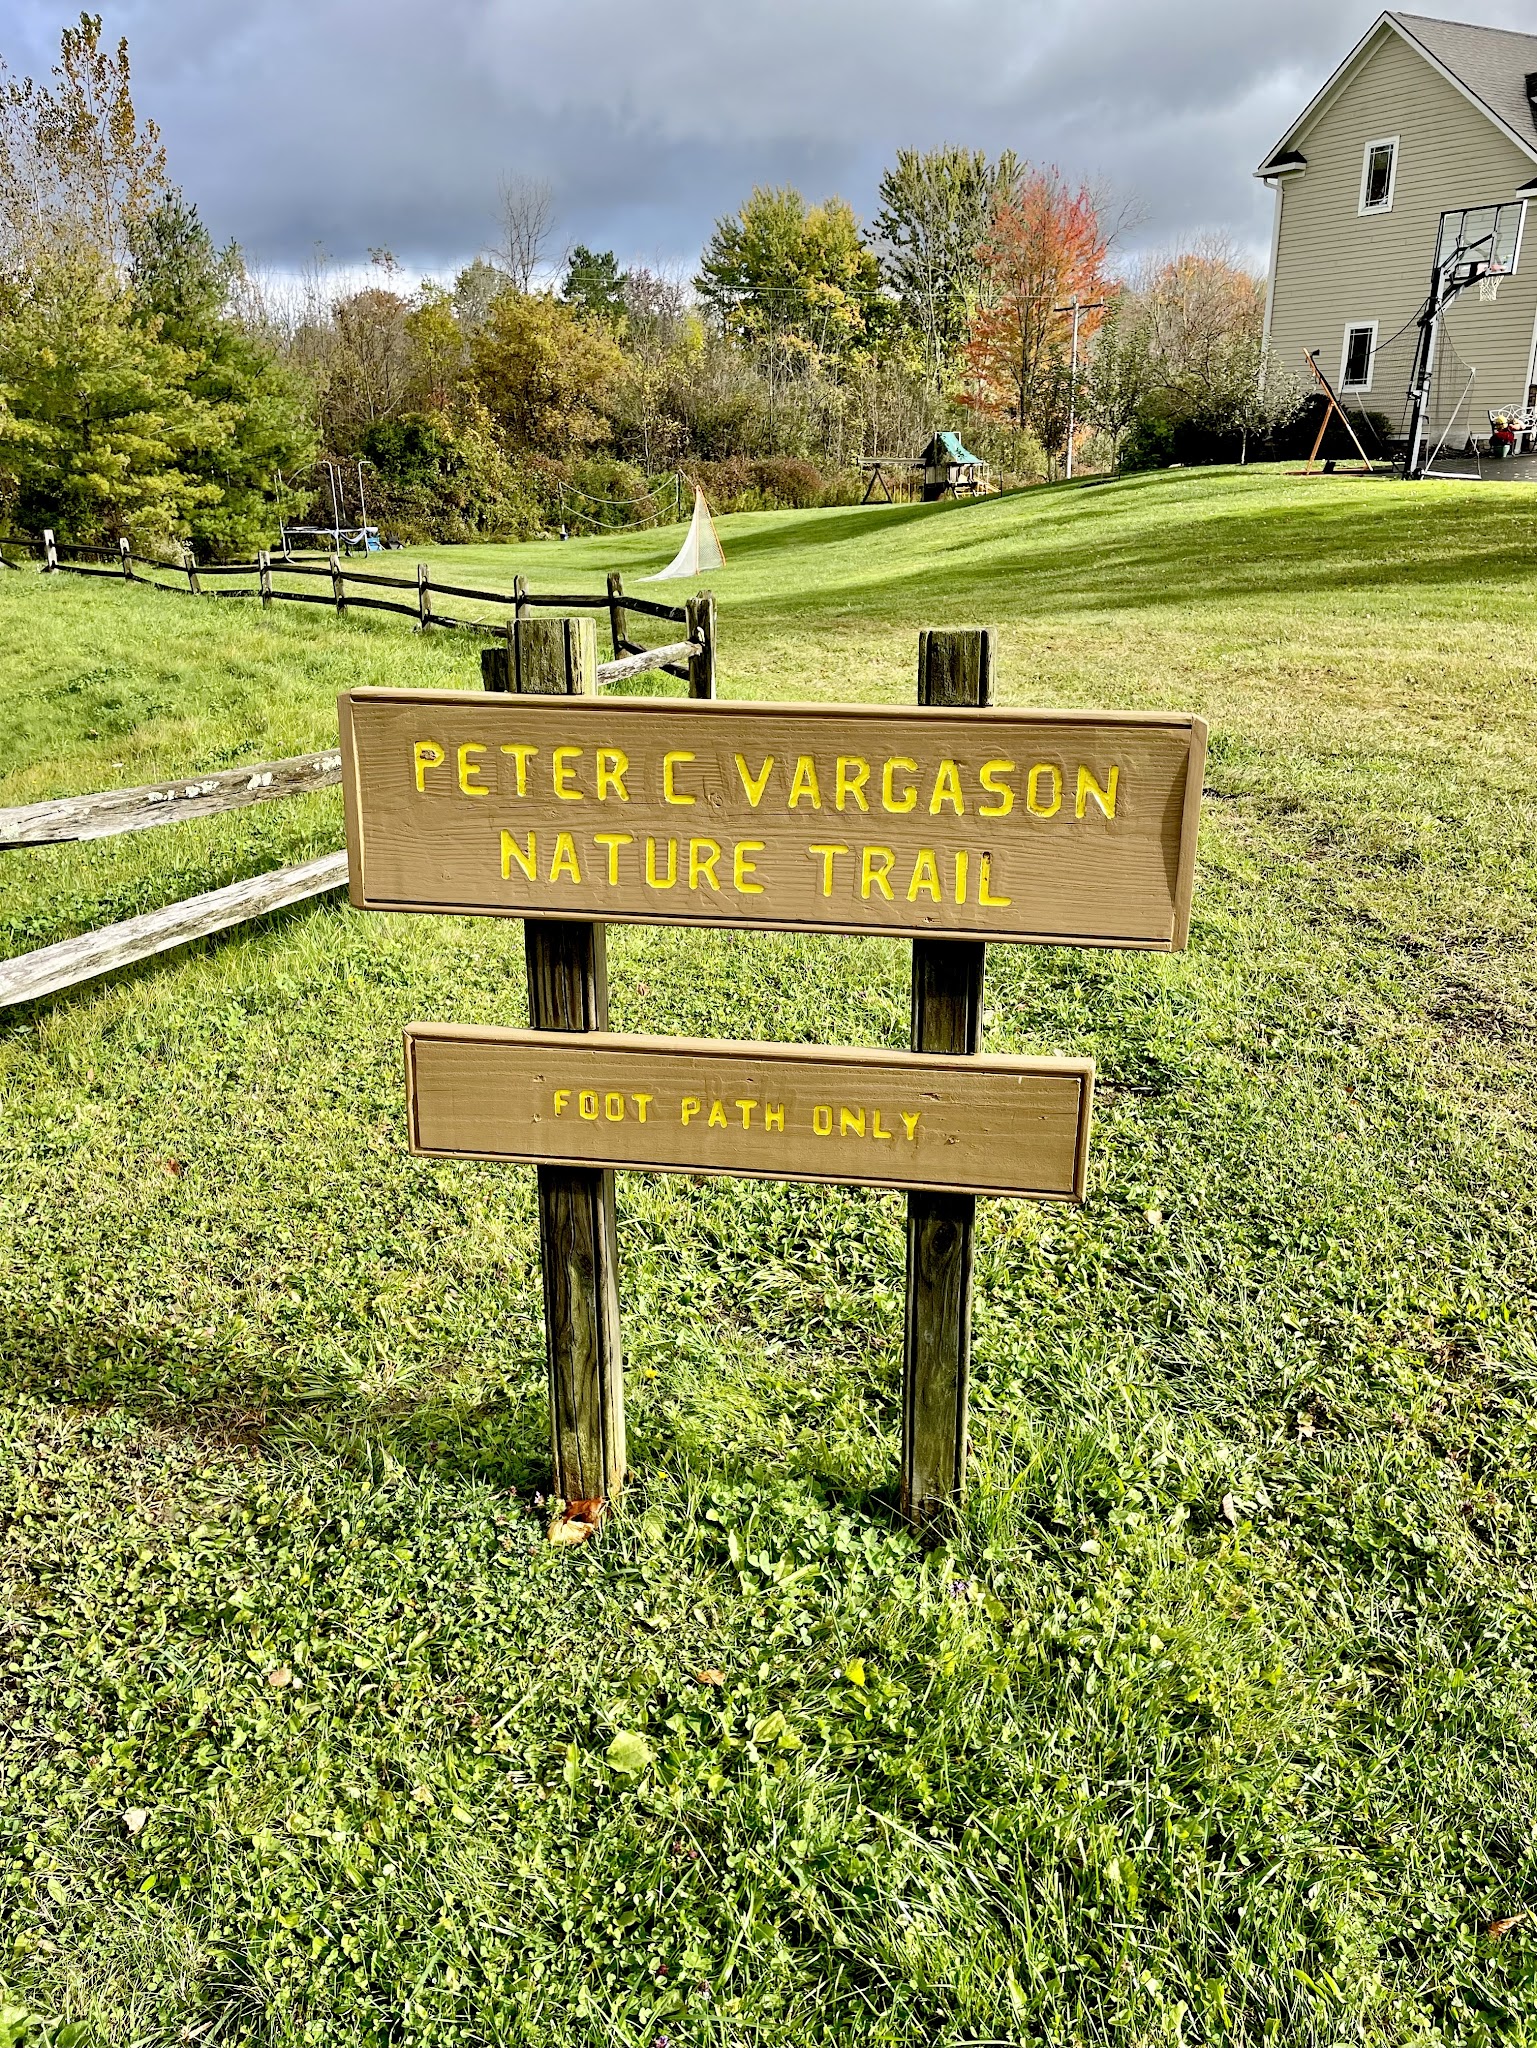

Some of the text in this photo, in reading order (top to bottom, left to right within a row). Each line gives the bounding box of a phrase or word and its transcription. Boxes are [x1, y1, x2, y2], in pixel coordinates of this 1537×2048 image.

[413, 737, 631, 804] PETER
[733, 752, 1121, 818] VARGASON
[500, 828, 1014, 907] NATURE TRAIL
[552, 1088, 923, 1142] FOOT PATH ONLY
